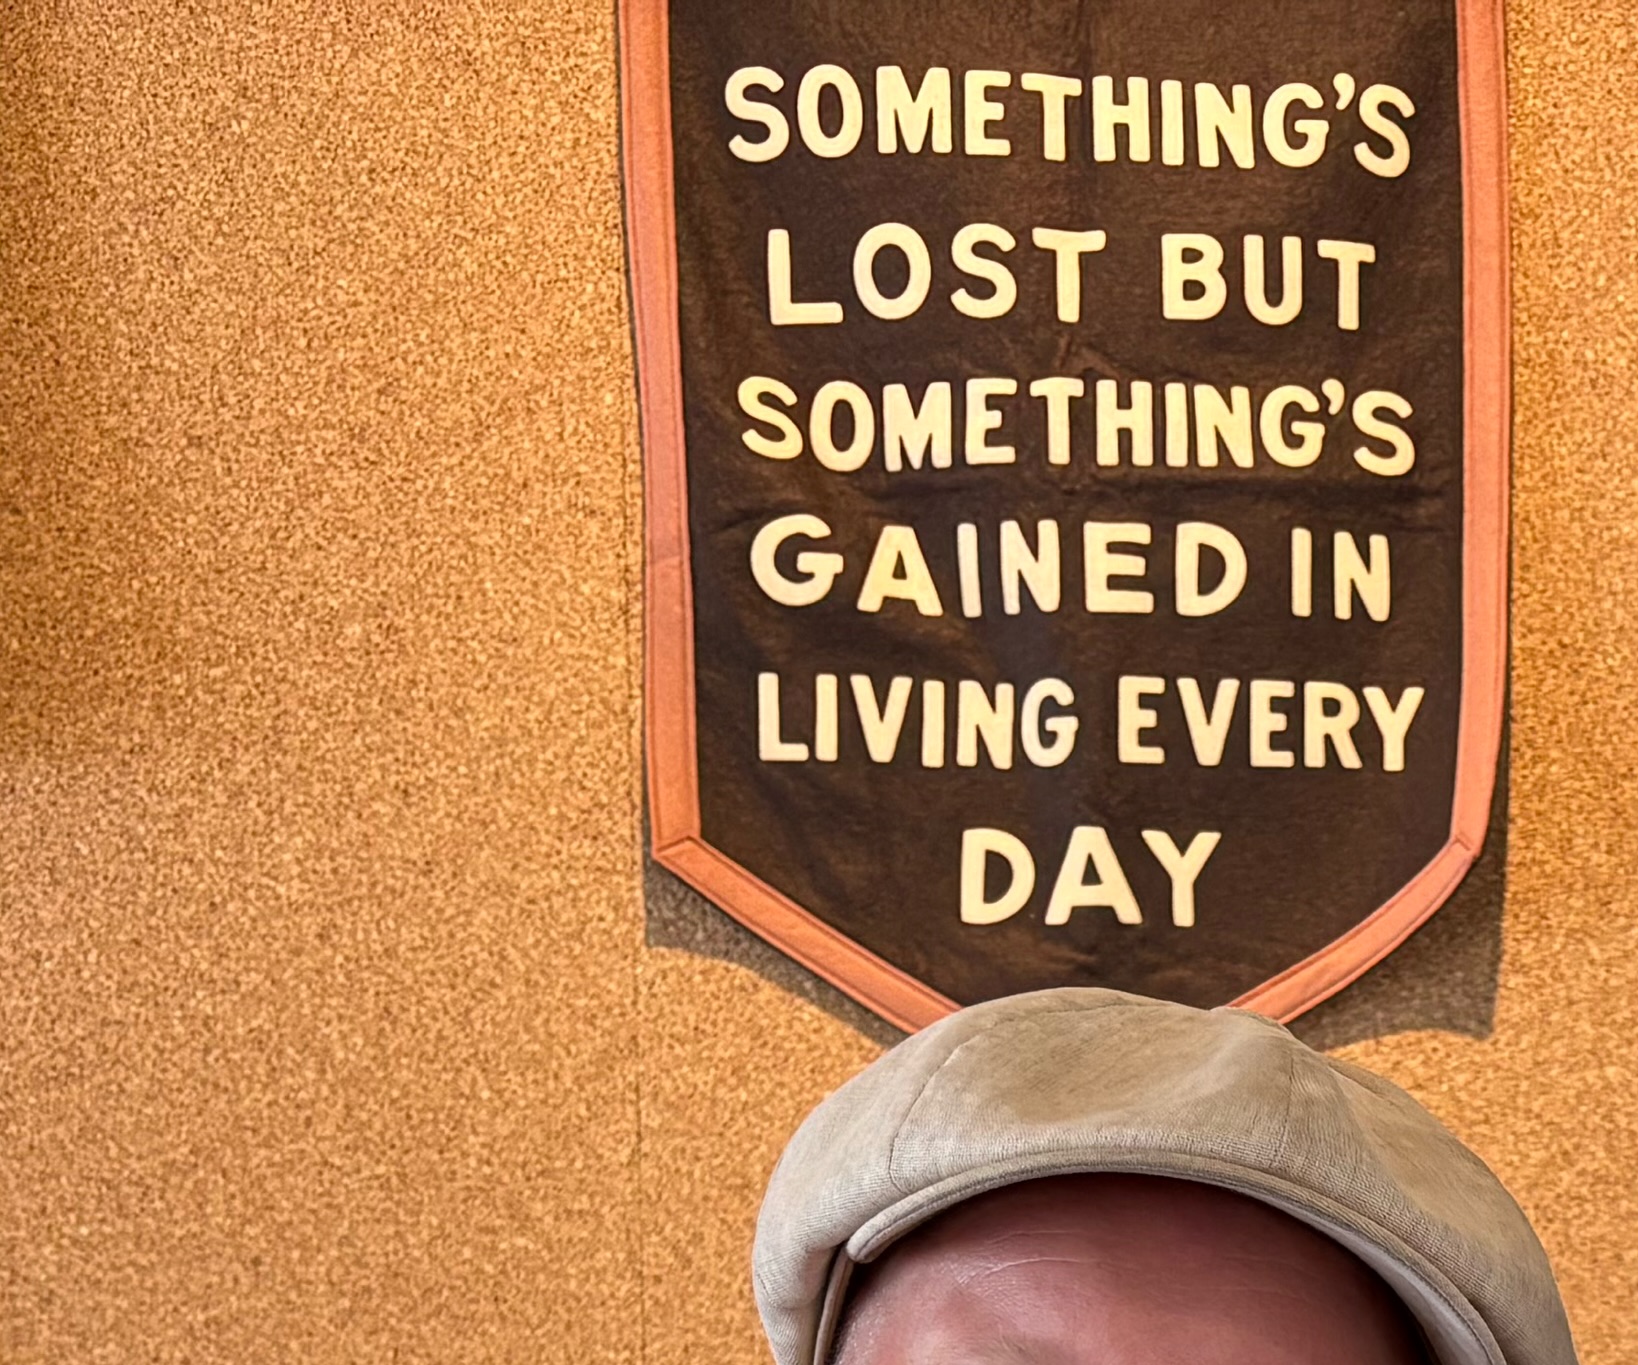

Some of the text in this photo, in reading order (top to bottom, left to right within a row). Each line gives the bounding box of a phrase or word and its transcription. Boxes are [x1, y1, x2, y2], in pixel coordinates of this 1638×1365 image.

[724, 63, 1416, 178] SOMETHING'S
[767, 222, 1376, 331] LOST BUT
[737, 375, 1416, 476] SOMETHING'S
[750, 513, 1391, 622] GAINED IN
[758, 672, 1425, 772] LIVING EVERY
[960, 825, 1222, 927] DAY
